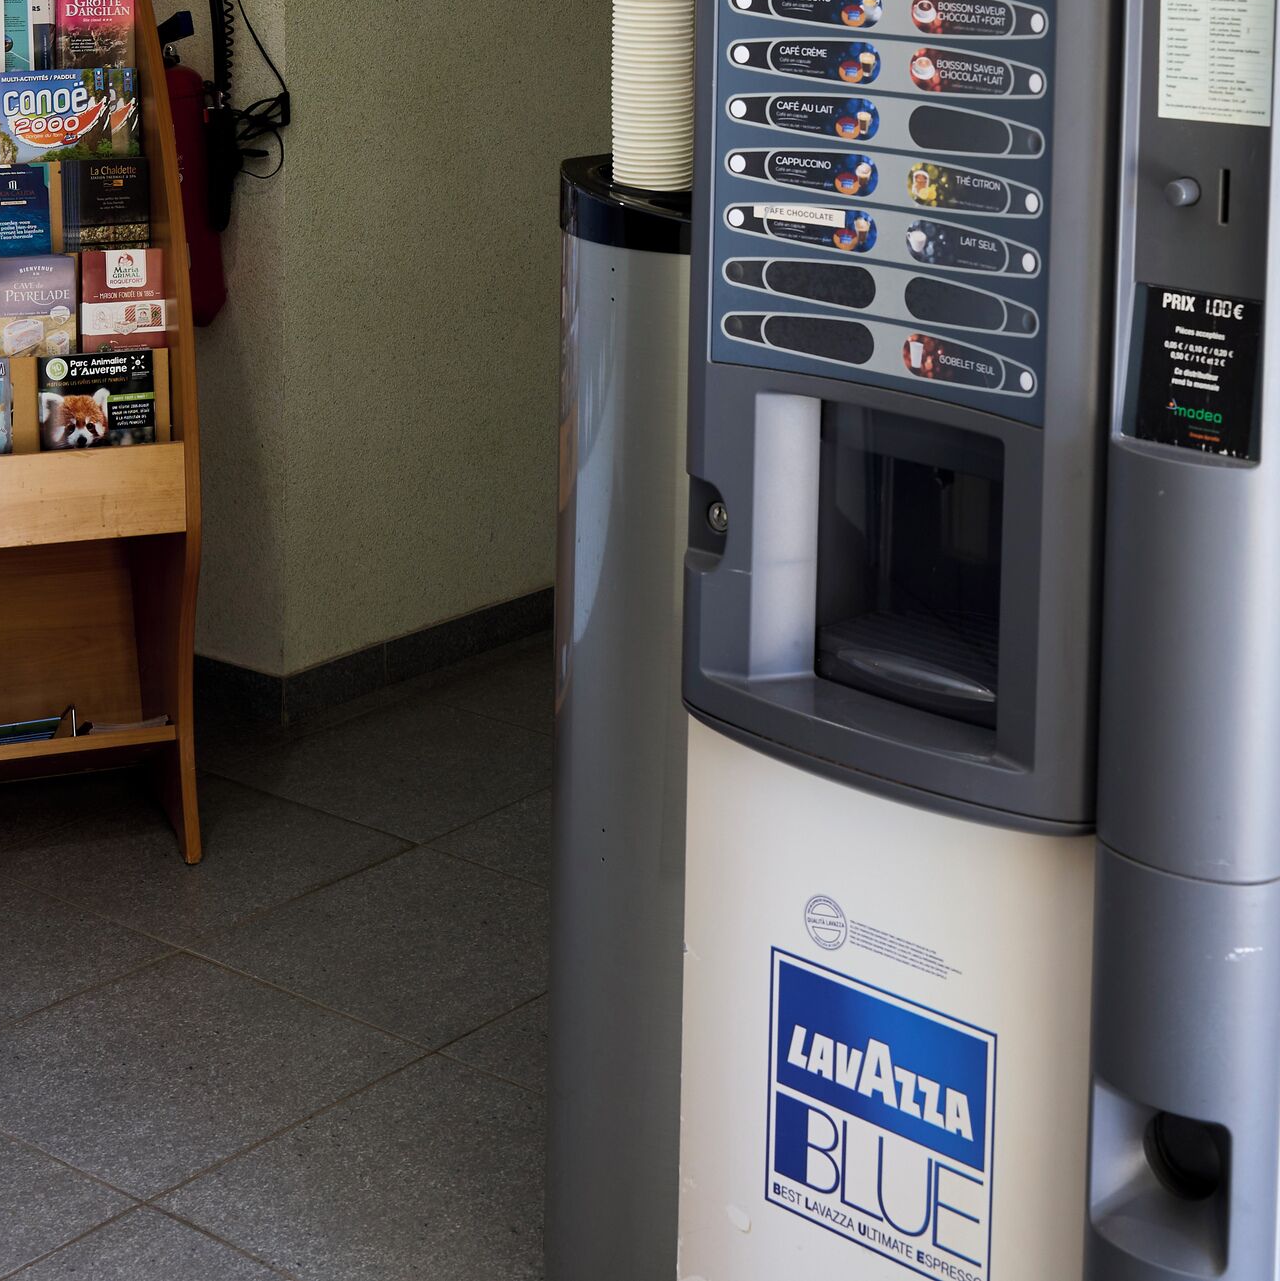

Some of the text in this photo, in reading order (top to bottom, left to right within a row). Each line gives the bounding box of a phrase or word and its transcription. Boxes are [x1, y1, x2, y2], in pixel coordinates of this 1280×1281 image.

[65, 4, 130, 17] DARGILAN
[938, 1, 1006, 17] BOISSON SAVEUR
[779, 45, 800, 56] CAFÉ
[937, 59, 1004, 76] BOISSON SAVEUR
[1, 74, 48, 83] MULTI-ACTIVITÉS
[3, 81, 88, 117] canoë
[776, 101, 834, 114] CAFÉ AU LAIT
[15, 117, 80, 135] 2000
[91, 165, 137, 176] La Chaldette
[776, 156, 831, 170] CAPPUCCINO
[956, 175, 1001, 191] THÉ CITRON
[764, 206, 834, 221] CAFE CHOCOLATE
[960, 236, 997, 252] LAIT SEUL
[19, 266, 54, 274] BIENVENUE
[114, 266, 139, 274] Maria
[109, 278, 144, 286] ROQUEFORT
[5, 289, 70, 305] PEYRELADE
[1162, 292, 1196, 313] PRIX
[70, 356, 128, 368] Parc Animalier
[939, 355, 995, 376] GOBELET SEUL
[71, 364, 128, 376] d'Auvergne
[787, 1024, 974, 1142] LAVAZZA
[774, 1091, 984, 1268] BLUE
[773, 1181, 913, 1259] BEST LAVAZZA ULTIMATE
